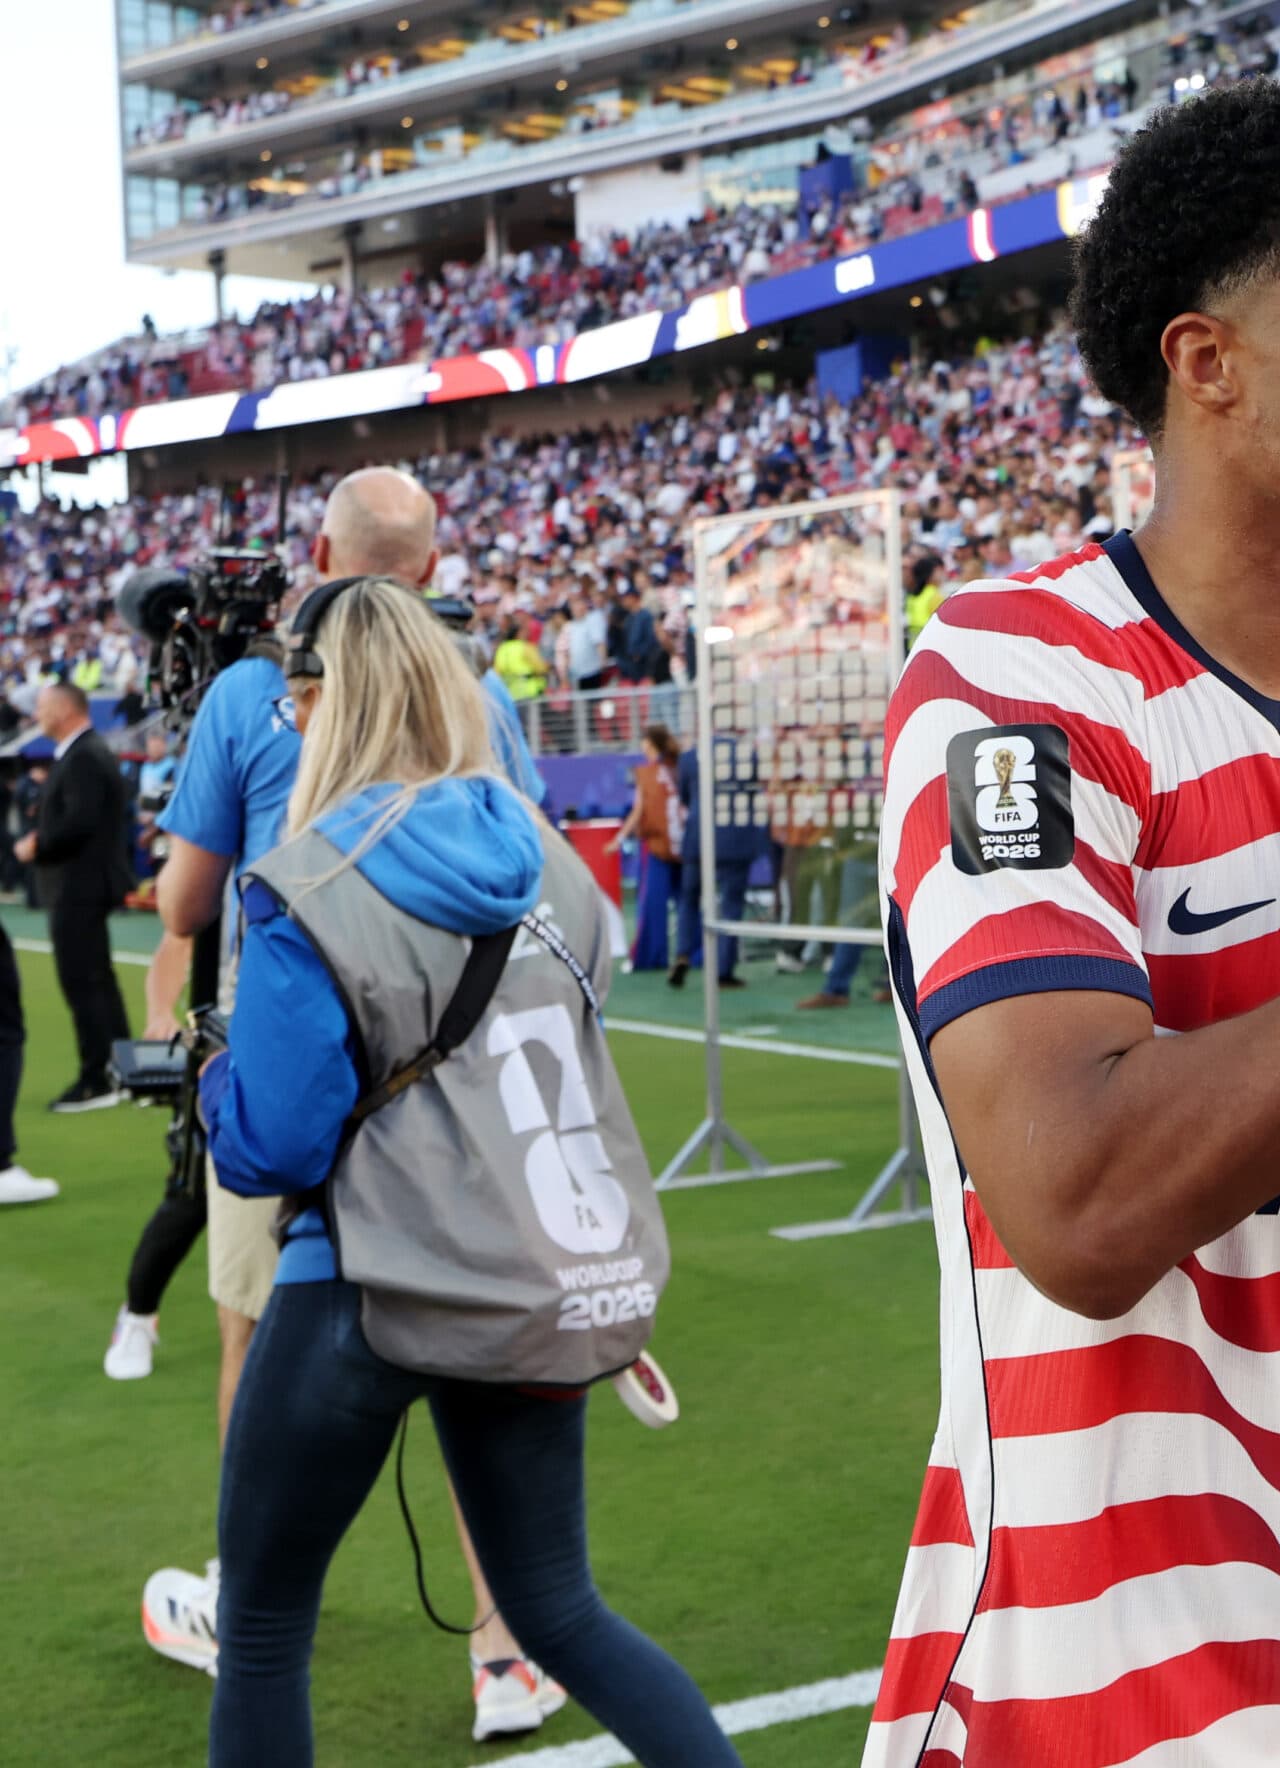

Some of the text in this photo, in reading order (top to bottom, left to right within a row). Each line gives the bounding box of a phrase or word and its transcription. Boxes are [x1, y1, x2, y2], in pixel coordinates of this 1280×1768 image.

[994, 811, 1022, 823] FIFA
[978, 832, 1041, 846] WORLD CUP
[981, 843, 1042, 861] 2026
[556, 1281, 658, 1331] 2026
